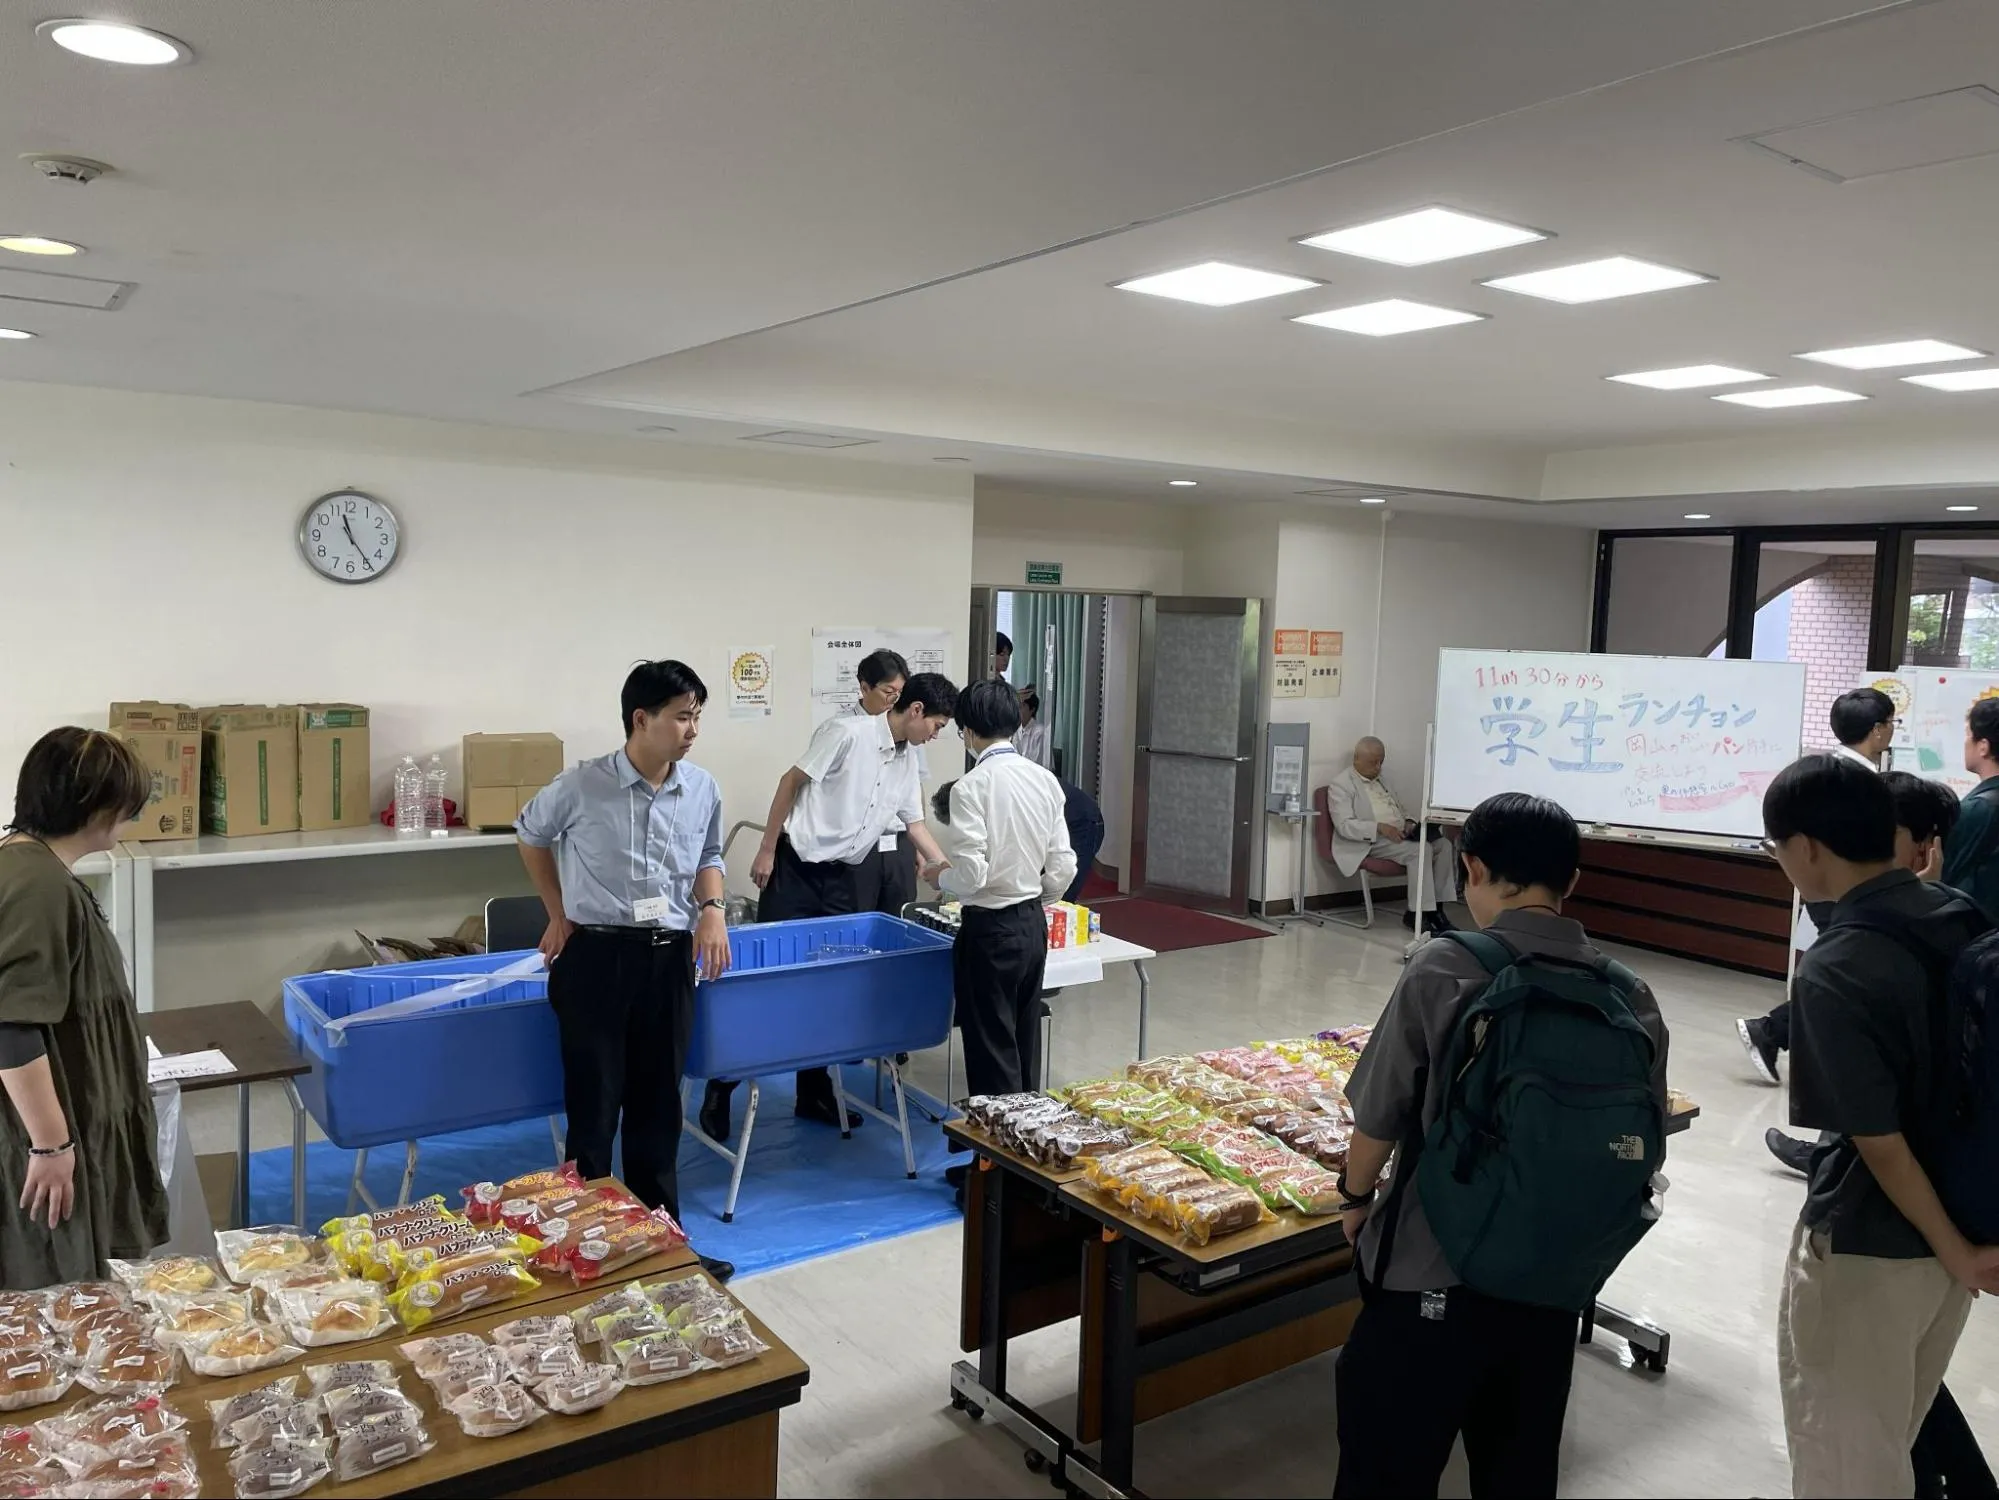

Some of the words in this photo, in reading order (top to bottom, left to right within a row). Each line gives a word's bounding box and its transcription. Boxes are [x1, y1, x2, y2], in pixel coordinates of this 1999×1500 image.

[331, 504, 340, 516] 11
[344, 501, 356, 513] 12
[317, 513, 330, 526] 10
[374, 517, 384, 529] 2
[312, 529, 321, 542] 9
[380, 533, 389, 546] 3
[317, 545, 326, 558] 8
[374, 548, 383, 560] 4
[331, 556, 340, 569] 7
[346, 561, 355, 574] 6
[362, 558, 371, 571] 5
[1621, 1135, 1637, 1144] THE
[403, 1221, 473, 1246] バナナクリーム
